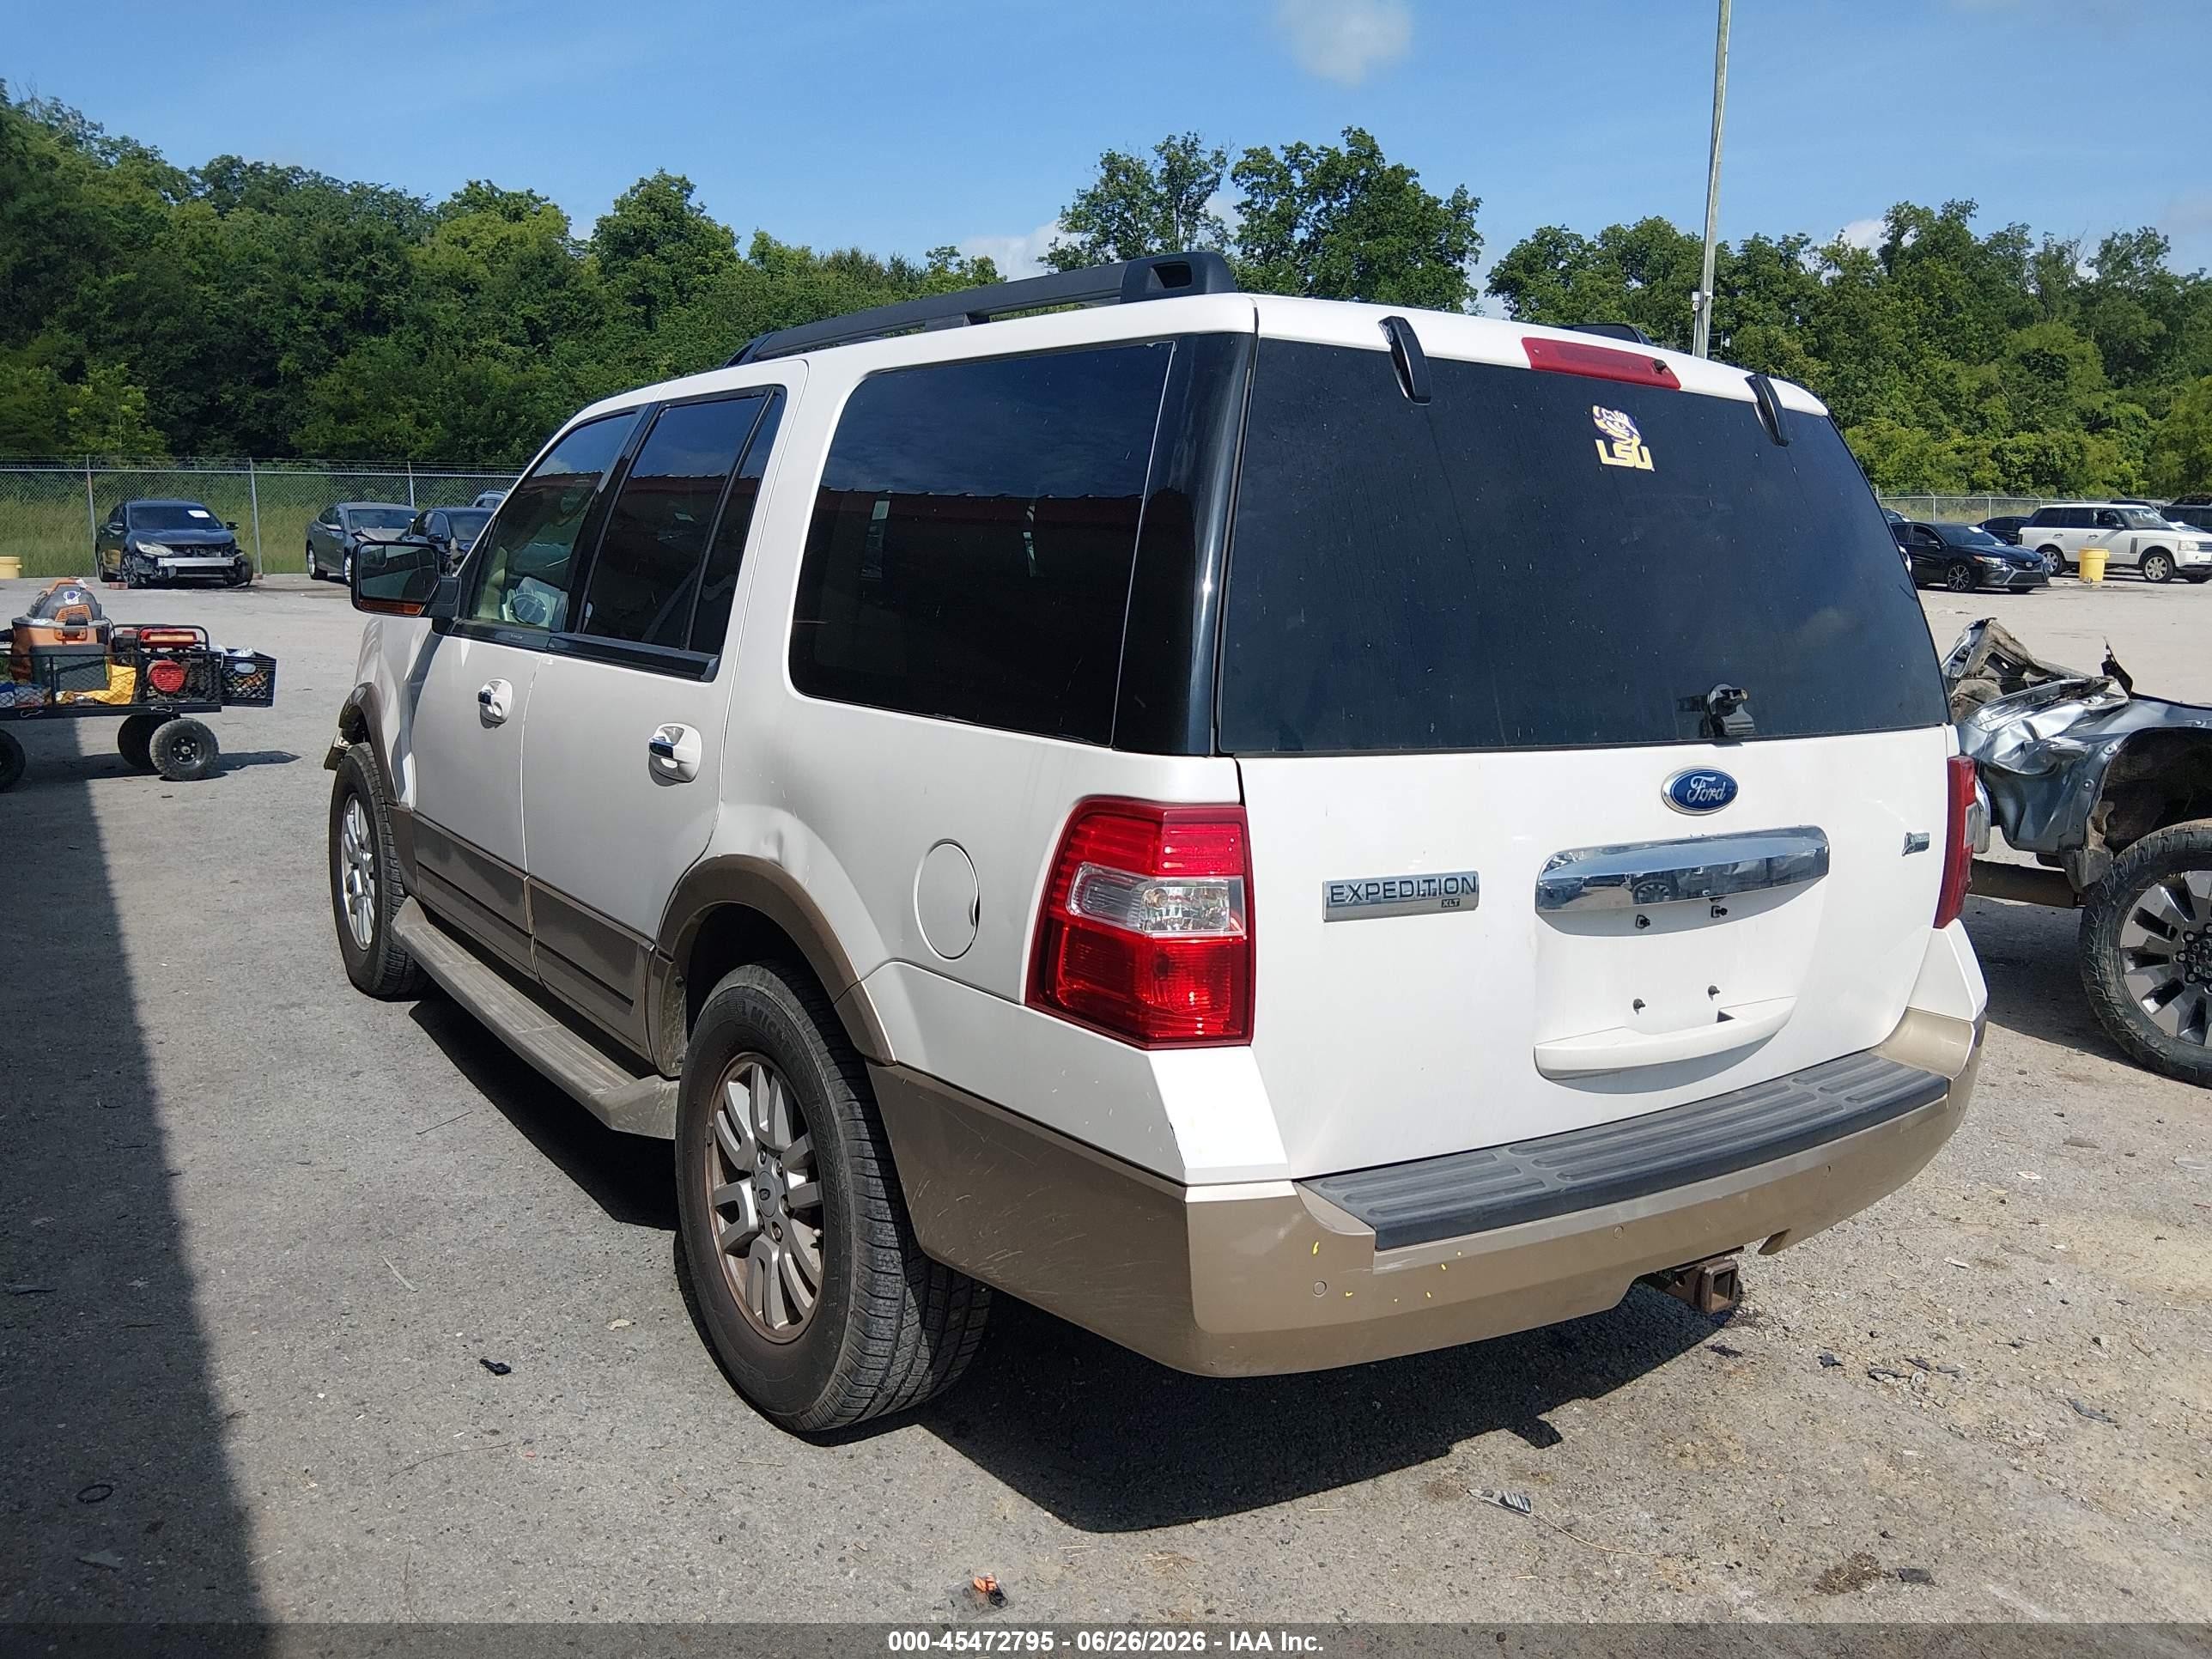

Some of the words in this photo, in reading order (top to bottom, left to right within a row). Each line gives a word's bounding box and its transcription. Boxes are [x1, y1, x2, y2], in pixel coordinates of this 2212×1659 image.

[1595, 439, 1653, 470] LSU
[1686, 775, 1727, 804] Ford
[1329, 875, 1477, 903] EXPEDITION
[1442, 898, 1460, 908] XLT
